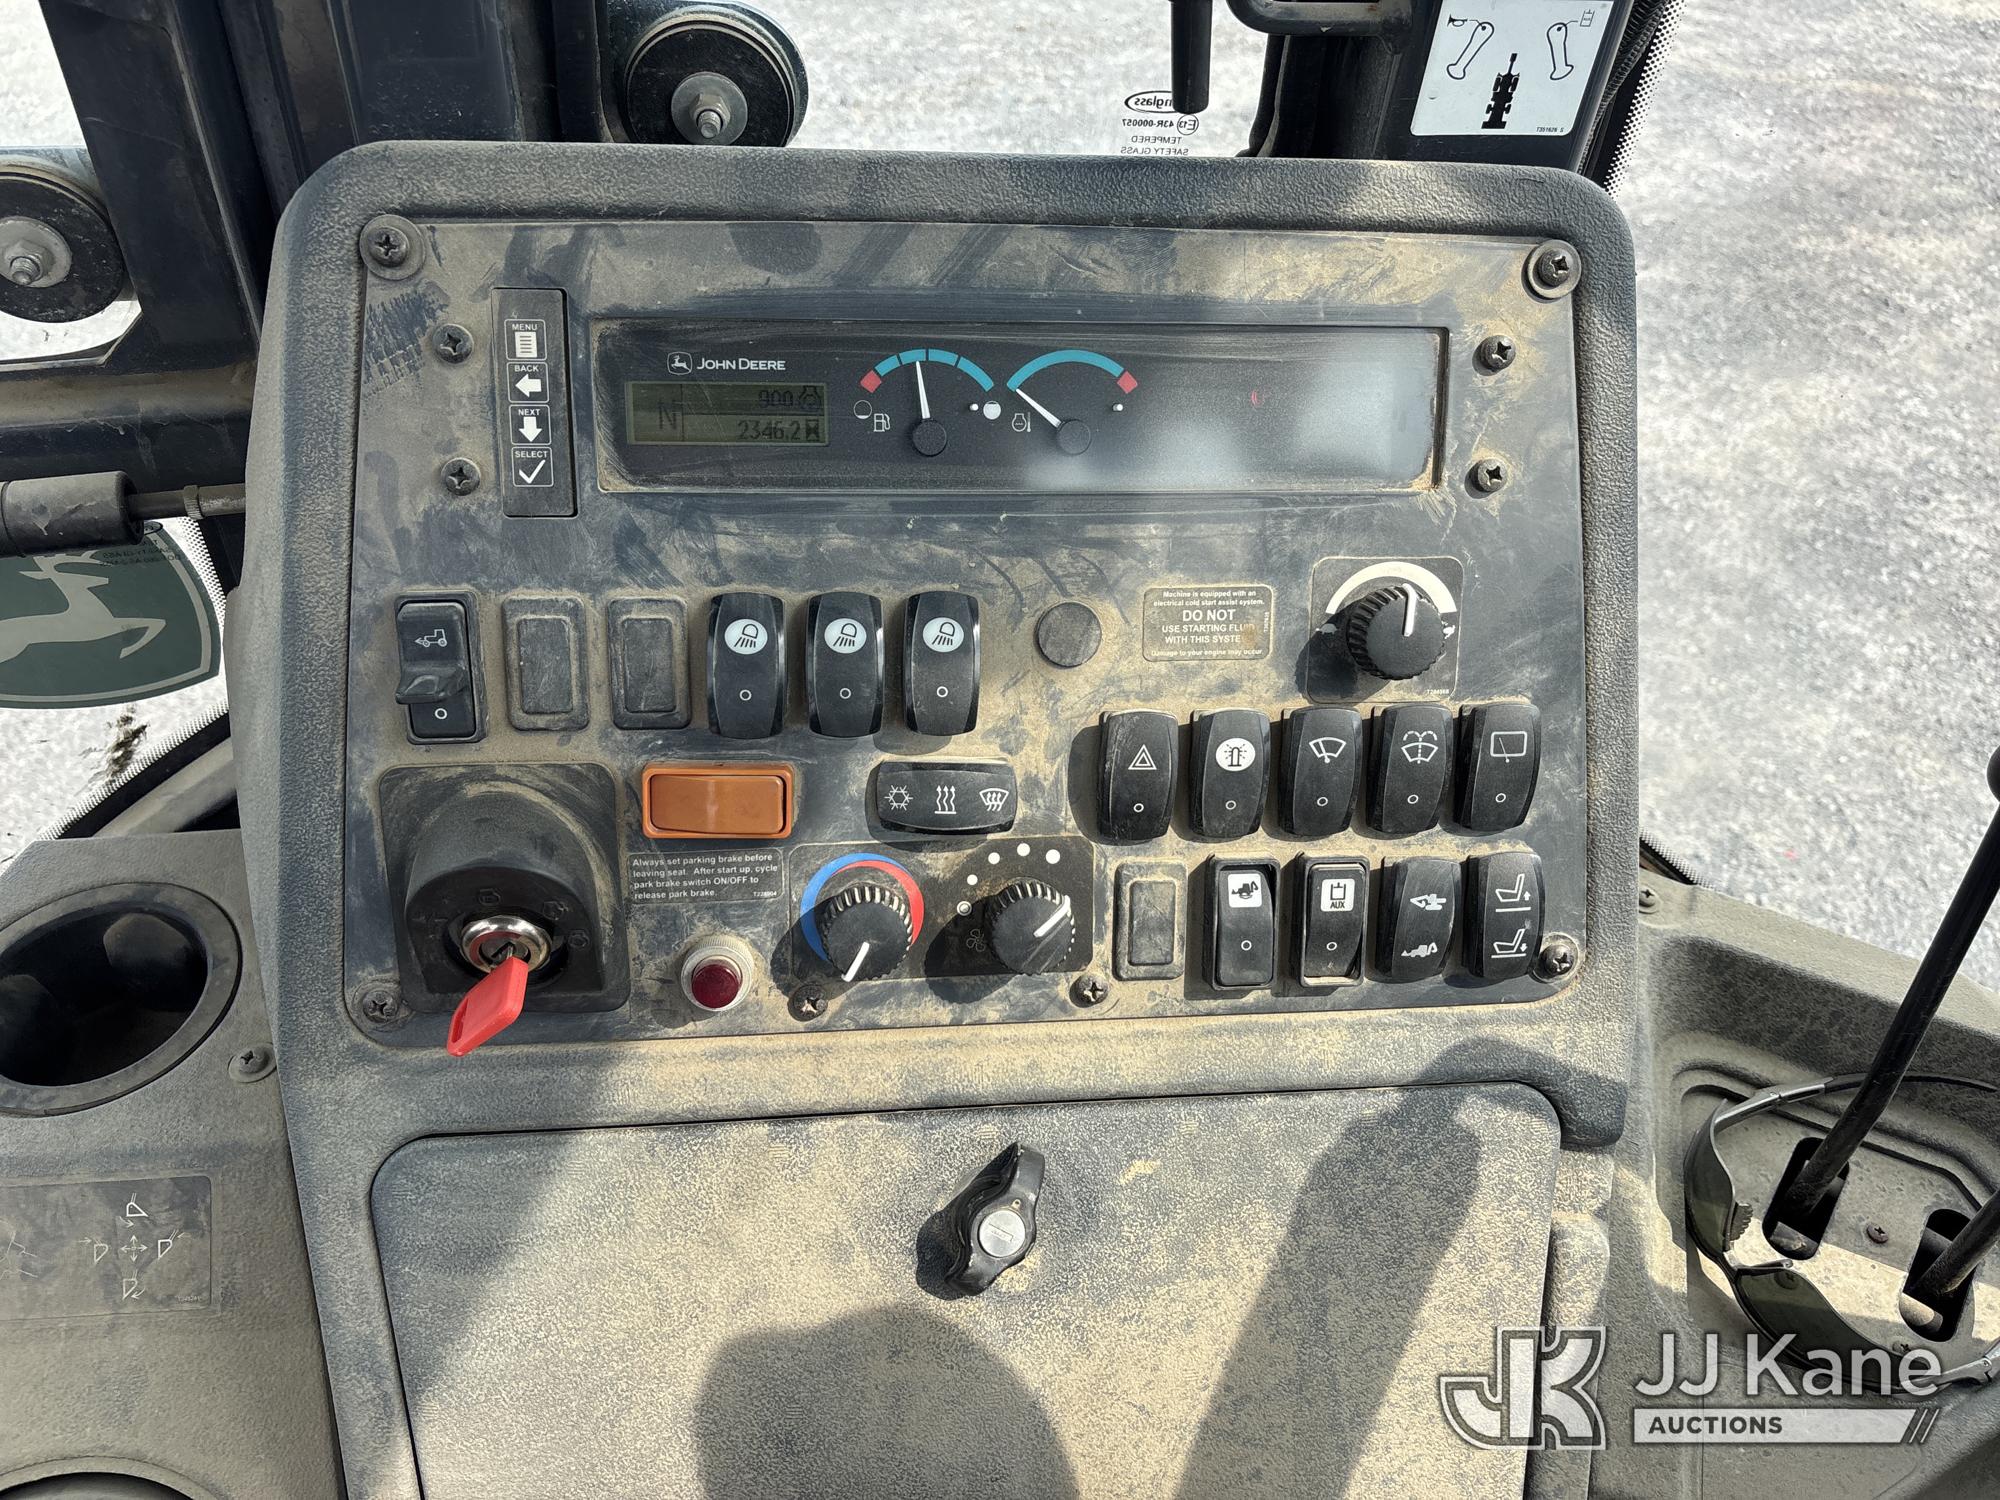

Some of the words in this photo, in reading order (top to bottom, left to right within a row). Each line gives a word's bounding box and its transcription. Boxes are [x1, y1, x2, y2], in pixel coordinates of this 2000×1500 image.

[511, 323, 538, 331] MENU
[696, 357, 736, 371] JOHN
[738, 358, 786, 371] DEERE
[518, 408, 541, 416] NEXT
[737, 420, 801, 440] 2346.2
[1182, 609, 1203, 621] DO
[1206, 609, 1236, 621] NOT
[1161, 624, 1180, 633] USE
[1182, 623, 1227, 633] STARTING
[1164, 635, 1188, 644] WITH
[1190, 635, 1210, 643] THIS
[632, 859, 665, 867] Always
[683, 857, 716, 866] parking
[718, 855, 743, 863] brake
[745, 854, 773, 862] before
[633, 870, 665, 878] leaving
[717, 866, 737, 874] start
[755, 865, 778, 873] cycle
[634, 881, 653, 890] park
[656, 880, 681, 888] brake
[682, 879, 711, 887] switch
[713, 876, 748, 885] ON/OFF
[634, 892, 667, 900] release
[668, 890, 688, 900] park
[1330, 901, 1345, 909] AUX
